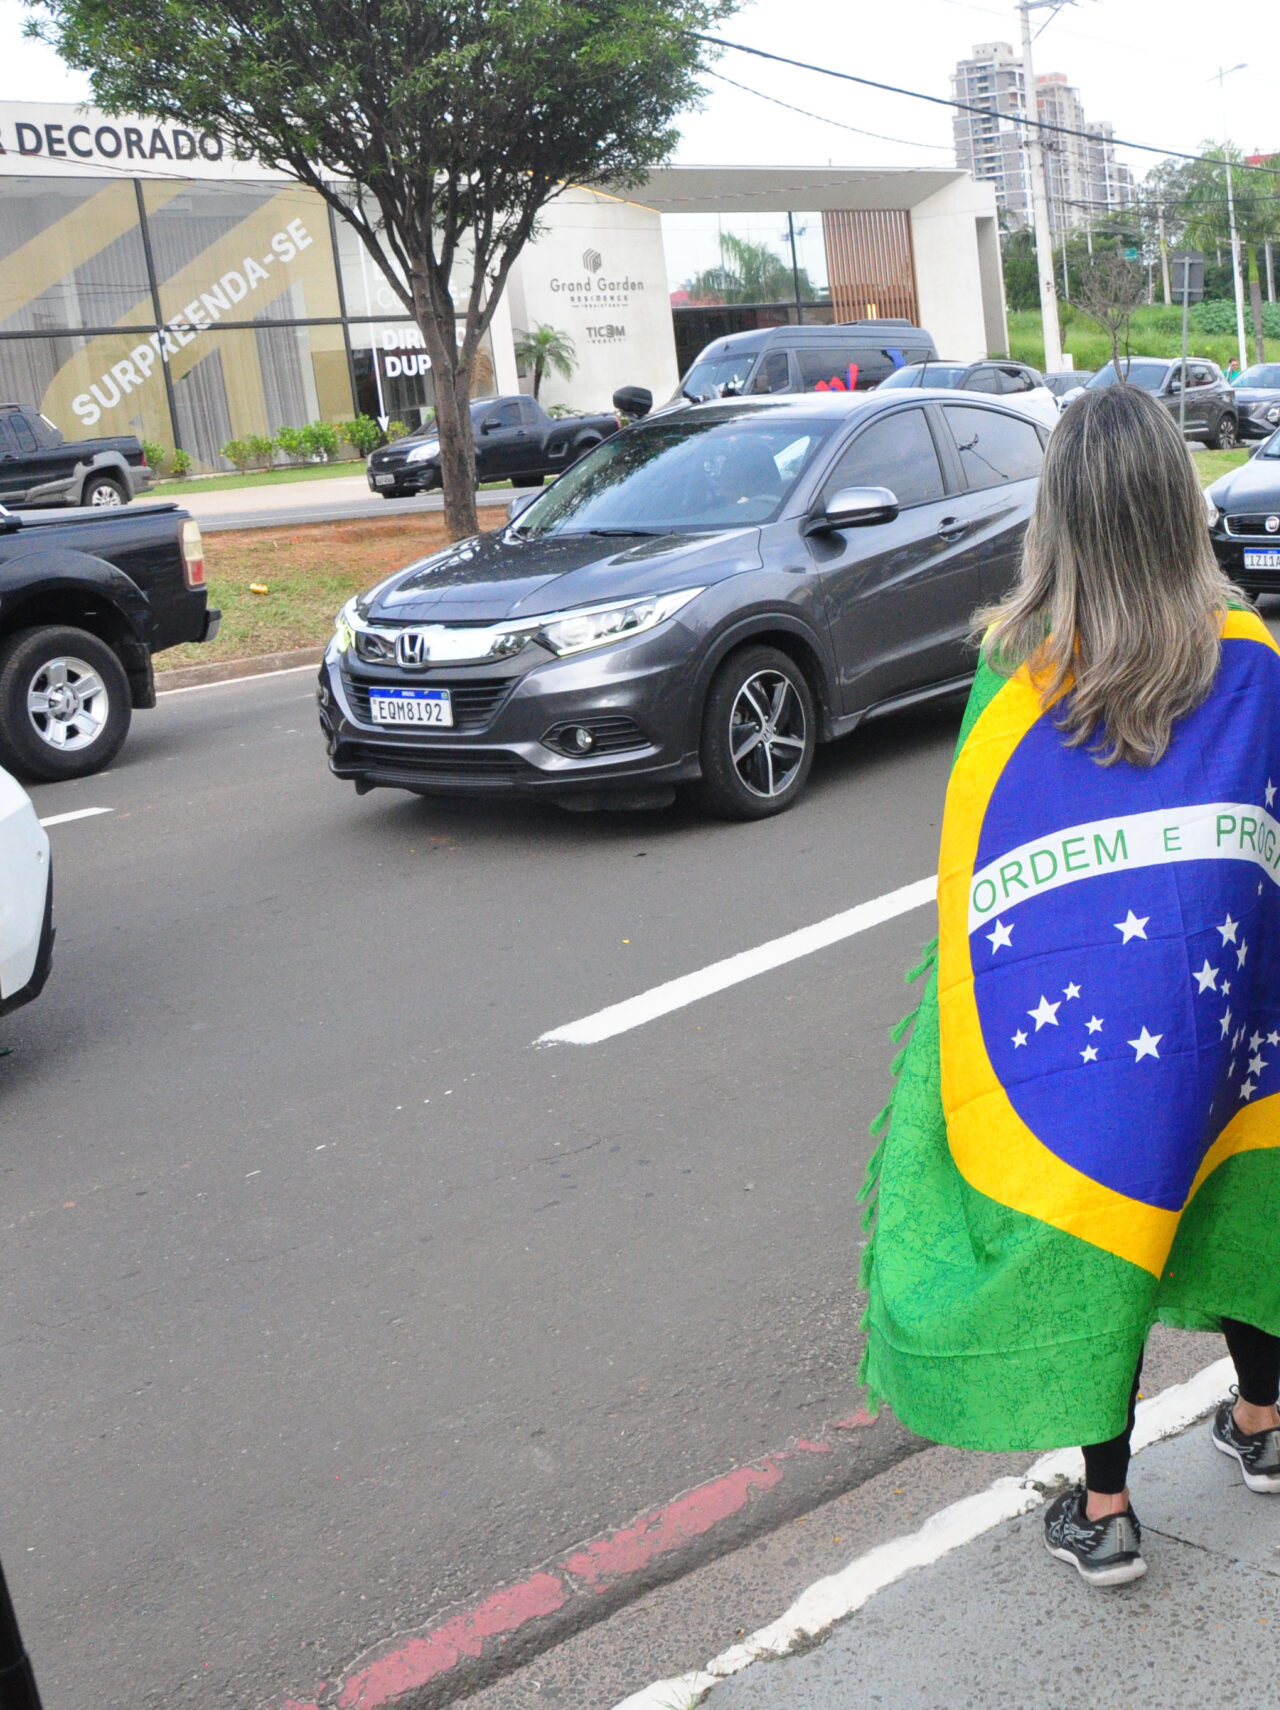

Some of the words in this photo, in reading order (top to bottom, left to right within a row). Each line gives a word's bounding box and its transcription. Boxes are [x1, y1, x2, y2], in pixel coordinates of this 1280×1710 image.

[15, 122, 223, 161] DECORADO
[550, 277, 591, 292] Grand
[597, 276, 644, 291] Garden
[72, 218, 313, 426] SURPREENDA-SE
[378, 701, 443, 722] EQM8I92
[972, 828, 1129, 914] ORDEM
[1163, 827, 1183, 852] E
